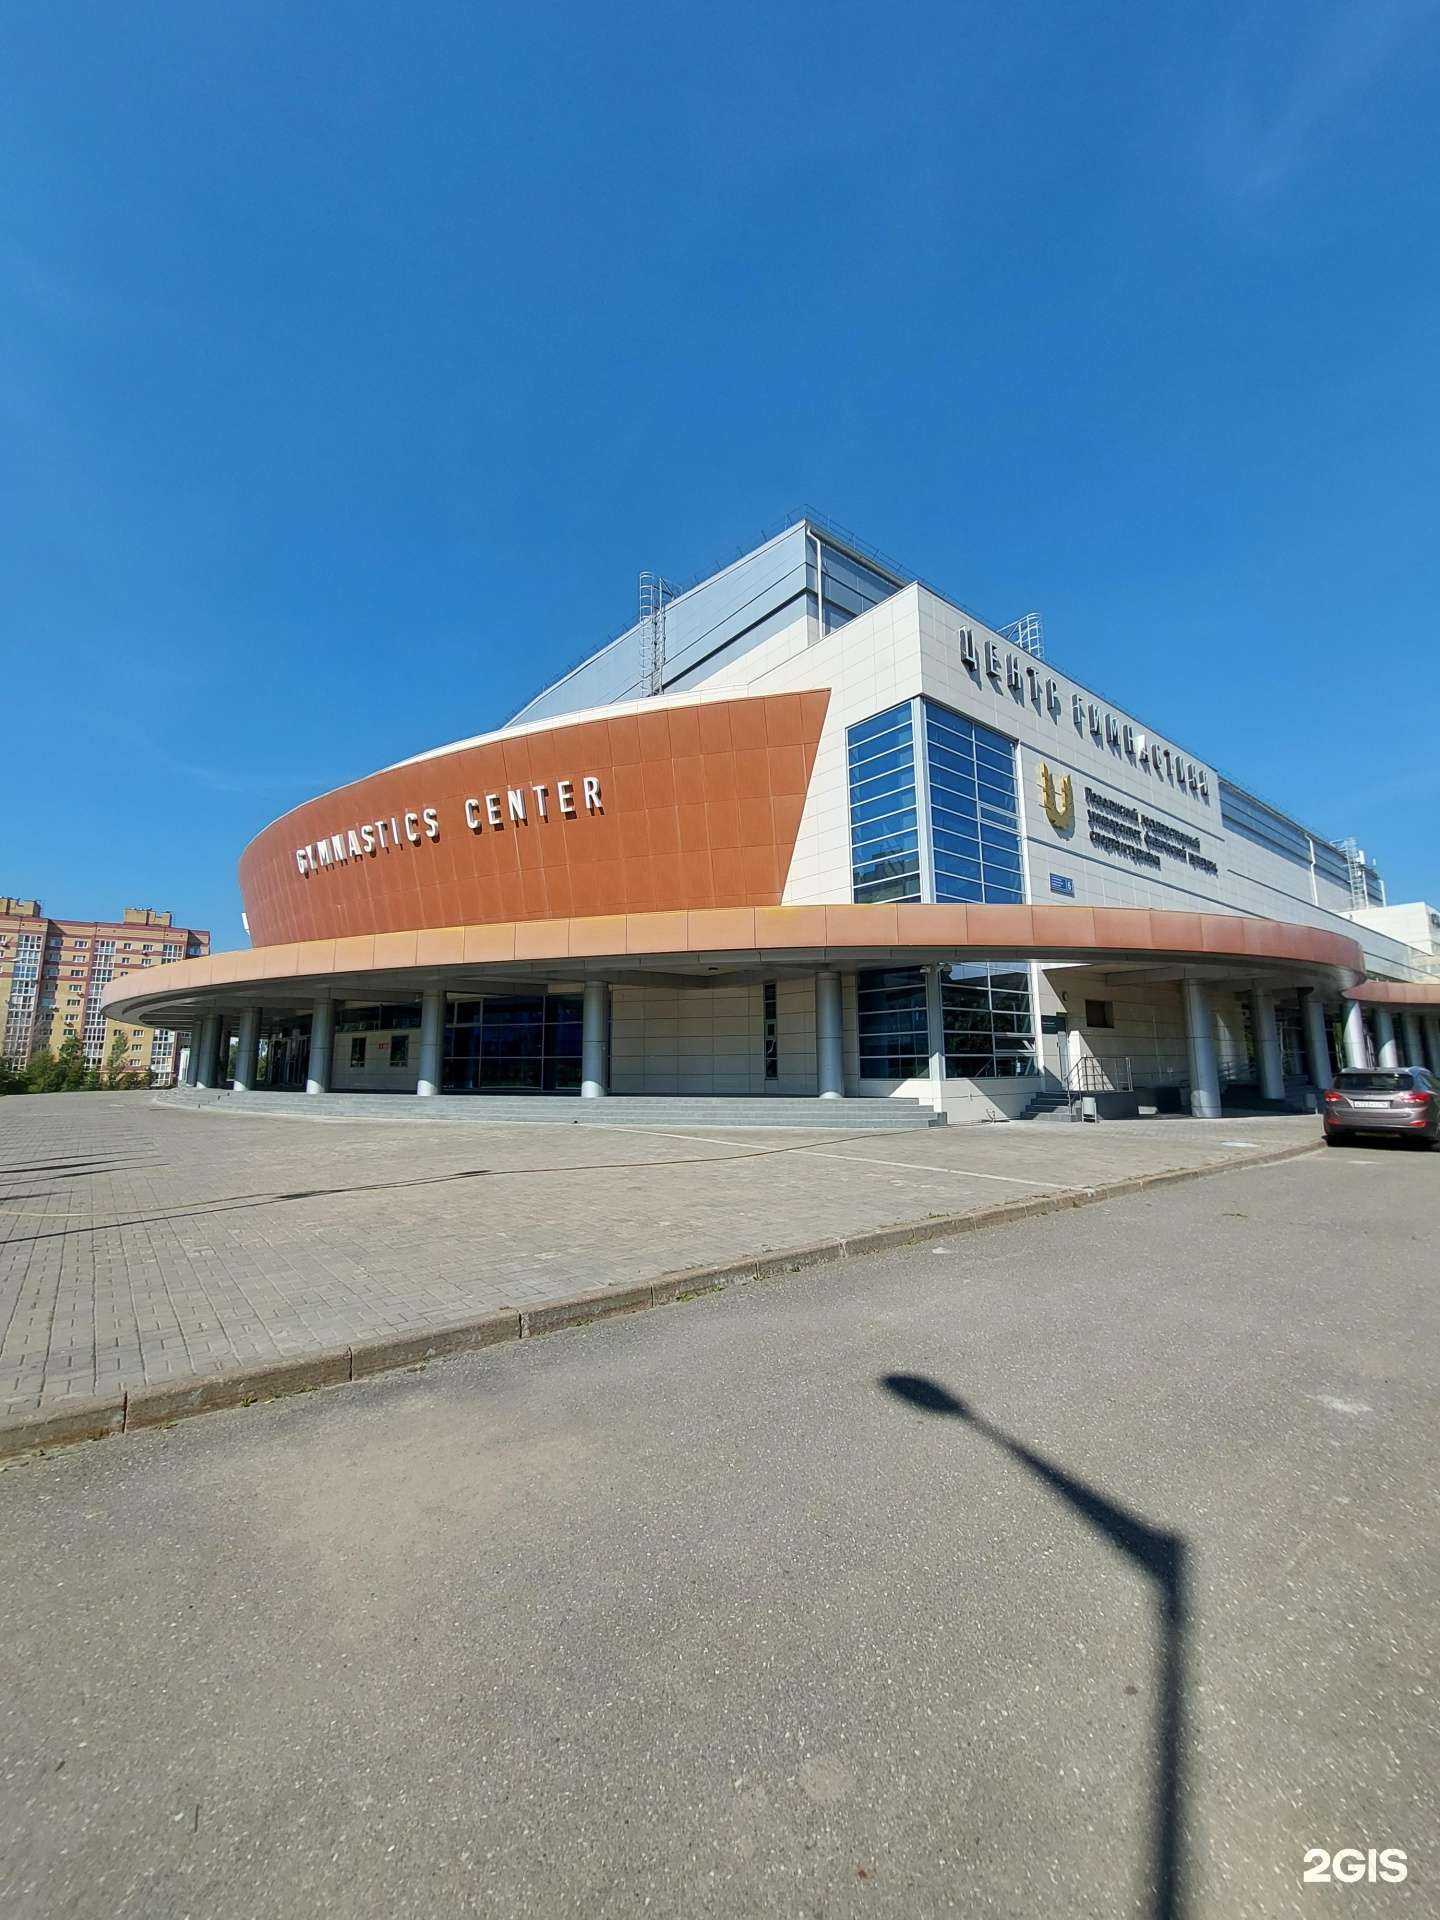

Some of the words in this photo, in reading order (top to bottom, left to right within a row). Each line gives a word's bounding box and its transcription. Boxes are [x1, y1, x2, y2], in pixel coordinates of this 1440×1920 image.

[959, 625, 1058, 709] ЦЕНТР
[296, 808, 439, 874] GYMNASTICS
[464, 776, 602, 829] CENTER
